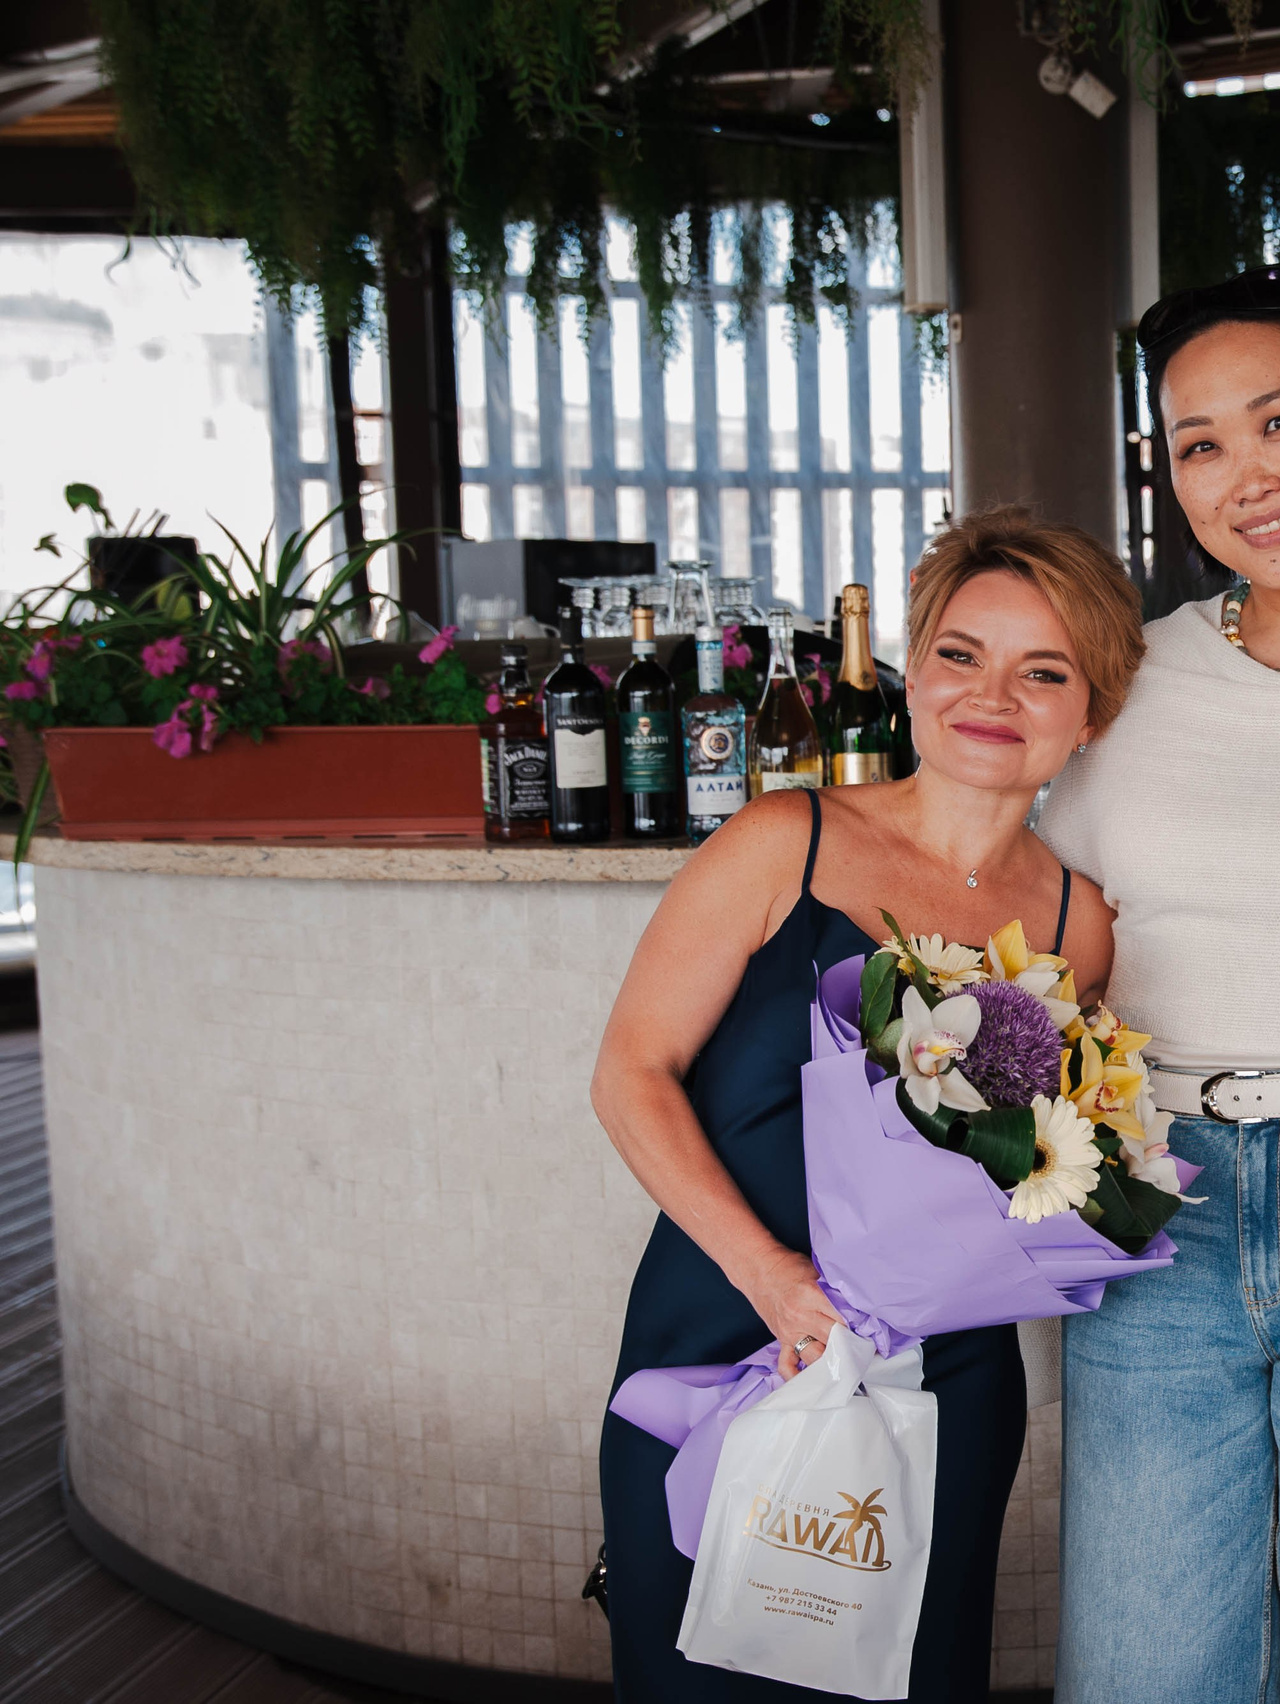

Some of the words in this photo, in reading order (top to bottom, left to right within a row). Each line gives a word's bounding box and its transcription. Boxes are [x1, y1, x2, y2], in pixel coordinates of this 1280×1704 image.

[624, 736, 668, 745] DECORDI
[503, 751, 524, 766] JACK
[695, 778, 743, 793] АЛТАЙ
[779, 1495, 830, 1517] ДЕРЕВНЯ
[745, 1494, 875, 1563] RAWAI
[747, 1578, 776, 1592] Казань,
[792, 1588, 850, 1609] Достоевского
[851, 1603, 863, 1611] 40
[764, 1605, 834, 1626] www.rawaispa.ru
[779, 1596, 795, 1605] 987
[797, 1600, 813, 1609] 215
[814, 1603, 825, 1613] 33
[826, 1607, 837, 1616] 44
